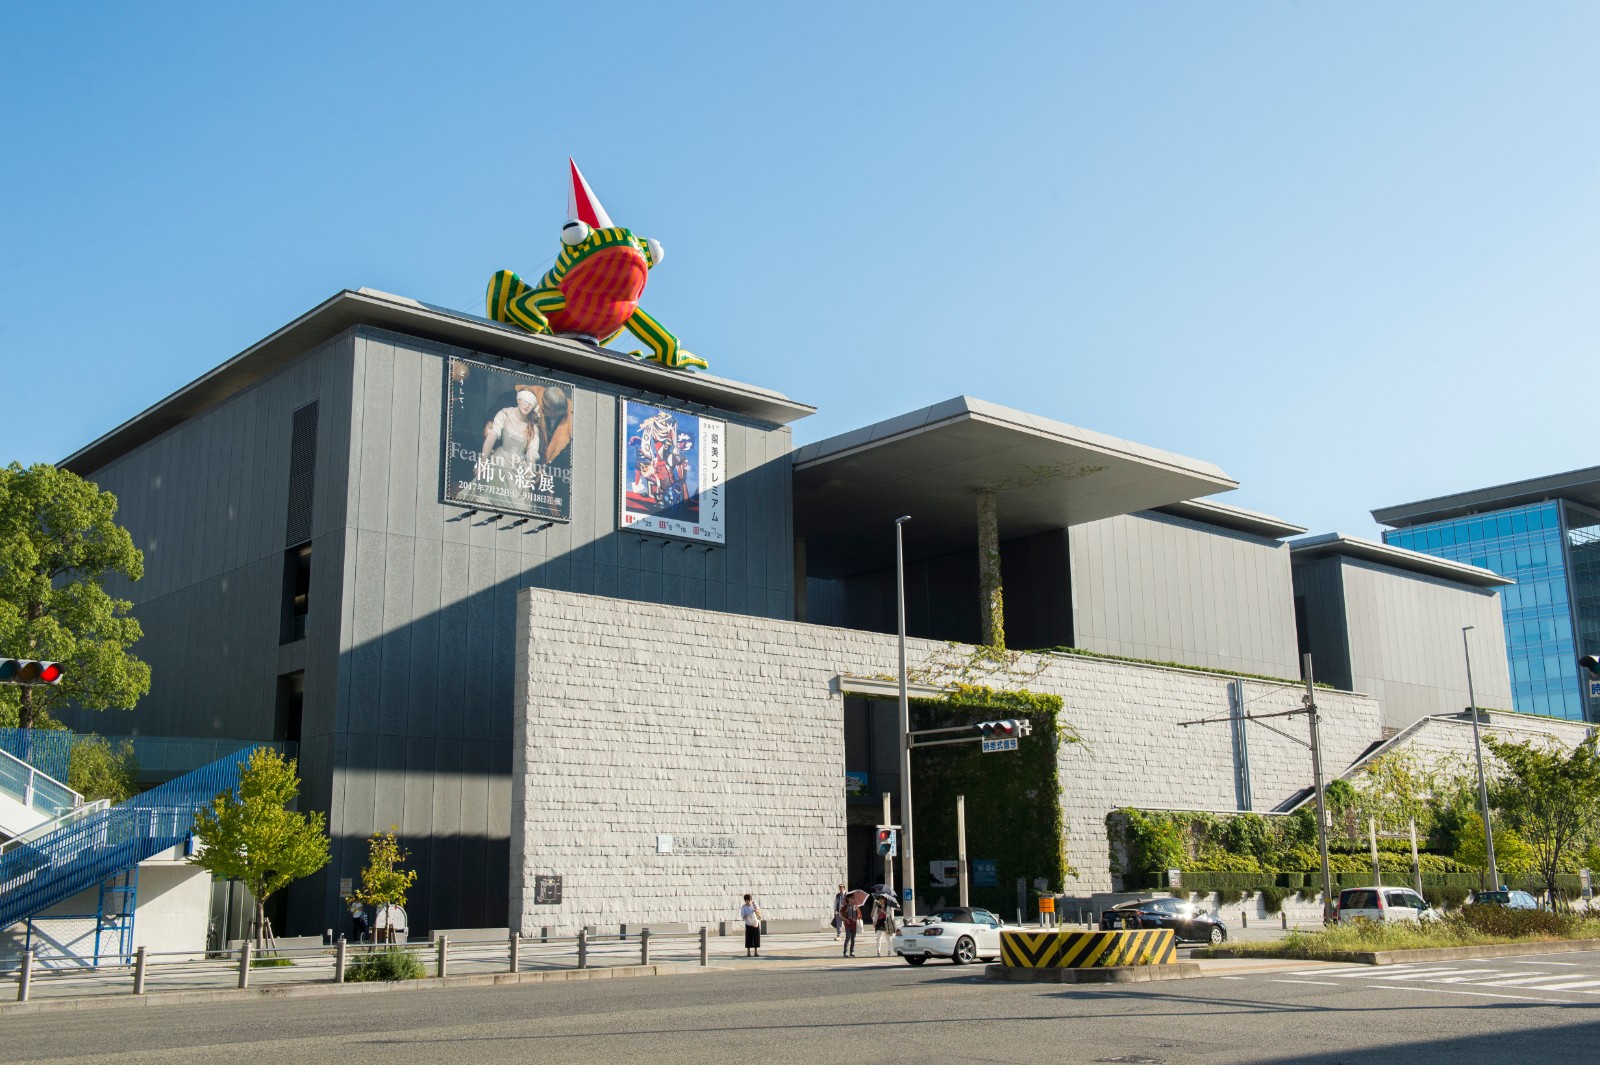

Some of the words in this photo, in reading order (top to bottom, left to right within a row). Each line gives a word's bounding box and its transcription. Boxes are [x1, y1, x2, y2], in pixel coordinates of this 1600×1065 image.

[451, 441, 484, 462] Fear
[490, 449, 504, 467] in
[511, 453, 570, 484] Painting
[474, 456, 555, 494] 怖い絵展
